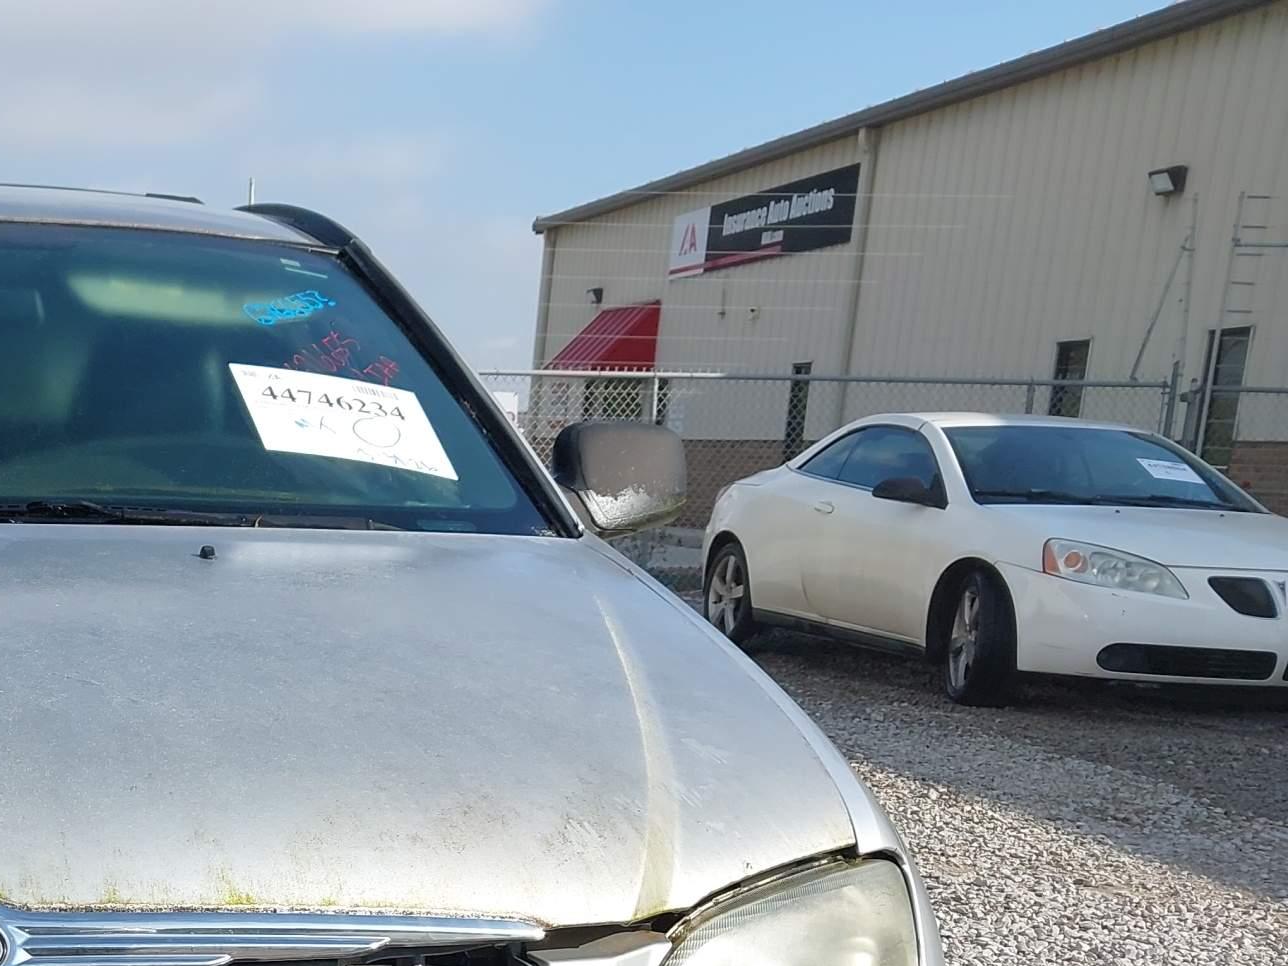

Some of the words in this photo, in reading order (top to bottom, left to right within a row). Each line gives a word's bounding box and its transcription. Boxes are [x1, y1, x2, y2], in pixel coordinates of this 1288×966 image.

[722, 206, 767, 236] Insurance
[767, 200, 790, 225] Auto
[789, 188, 834, 220] Auctions
[261, 385, 406, 421] 44746234
